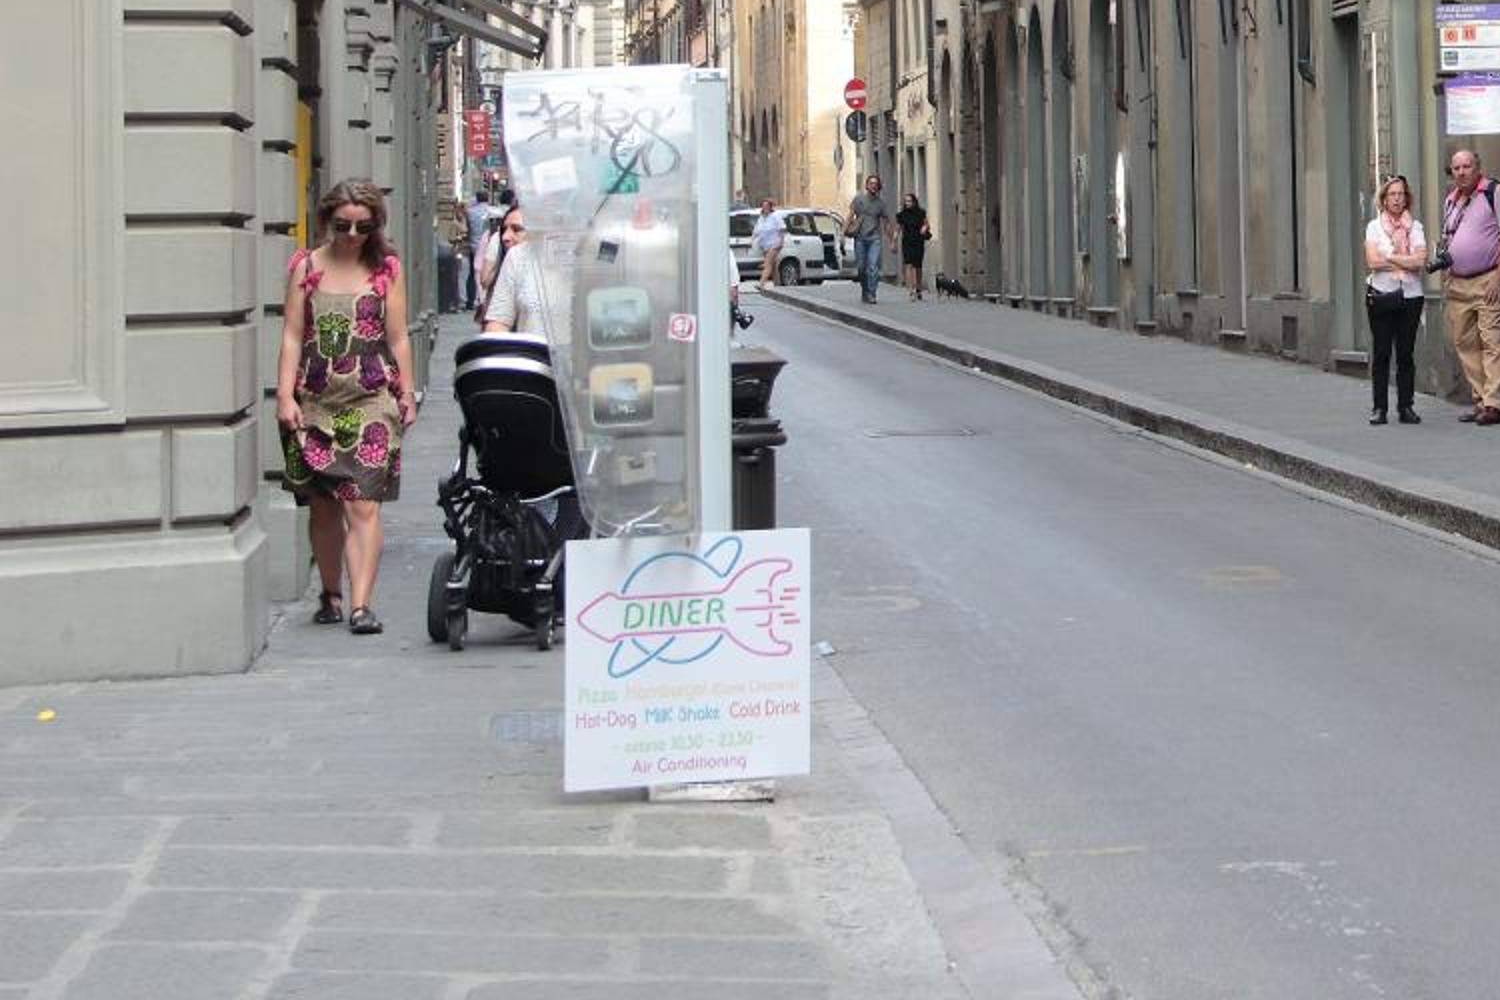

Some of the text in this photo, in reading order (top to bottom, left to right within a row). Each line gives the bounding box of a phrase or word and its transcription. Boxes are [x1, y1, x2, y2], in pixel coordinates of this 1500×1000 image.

[623, 597, 726, 630] DINER
[575, 710, 638, 730] Hot-Dog
[729, 701, 761, 718] Cold
[765, 698, 801, 716] Drink
[631, 755, 748, 774] Air Conditioning
